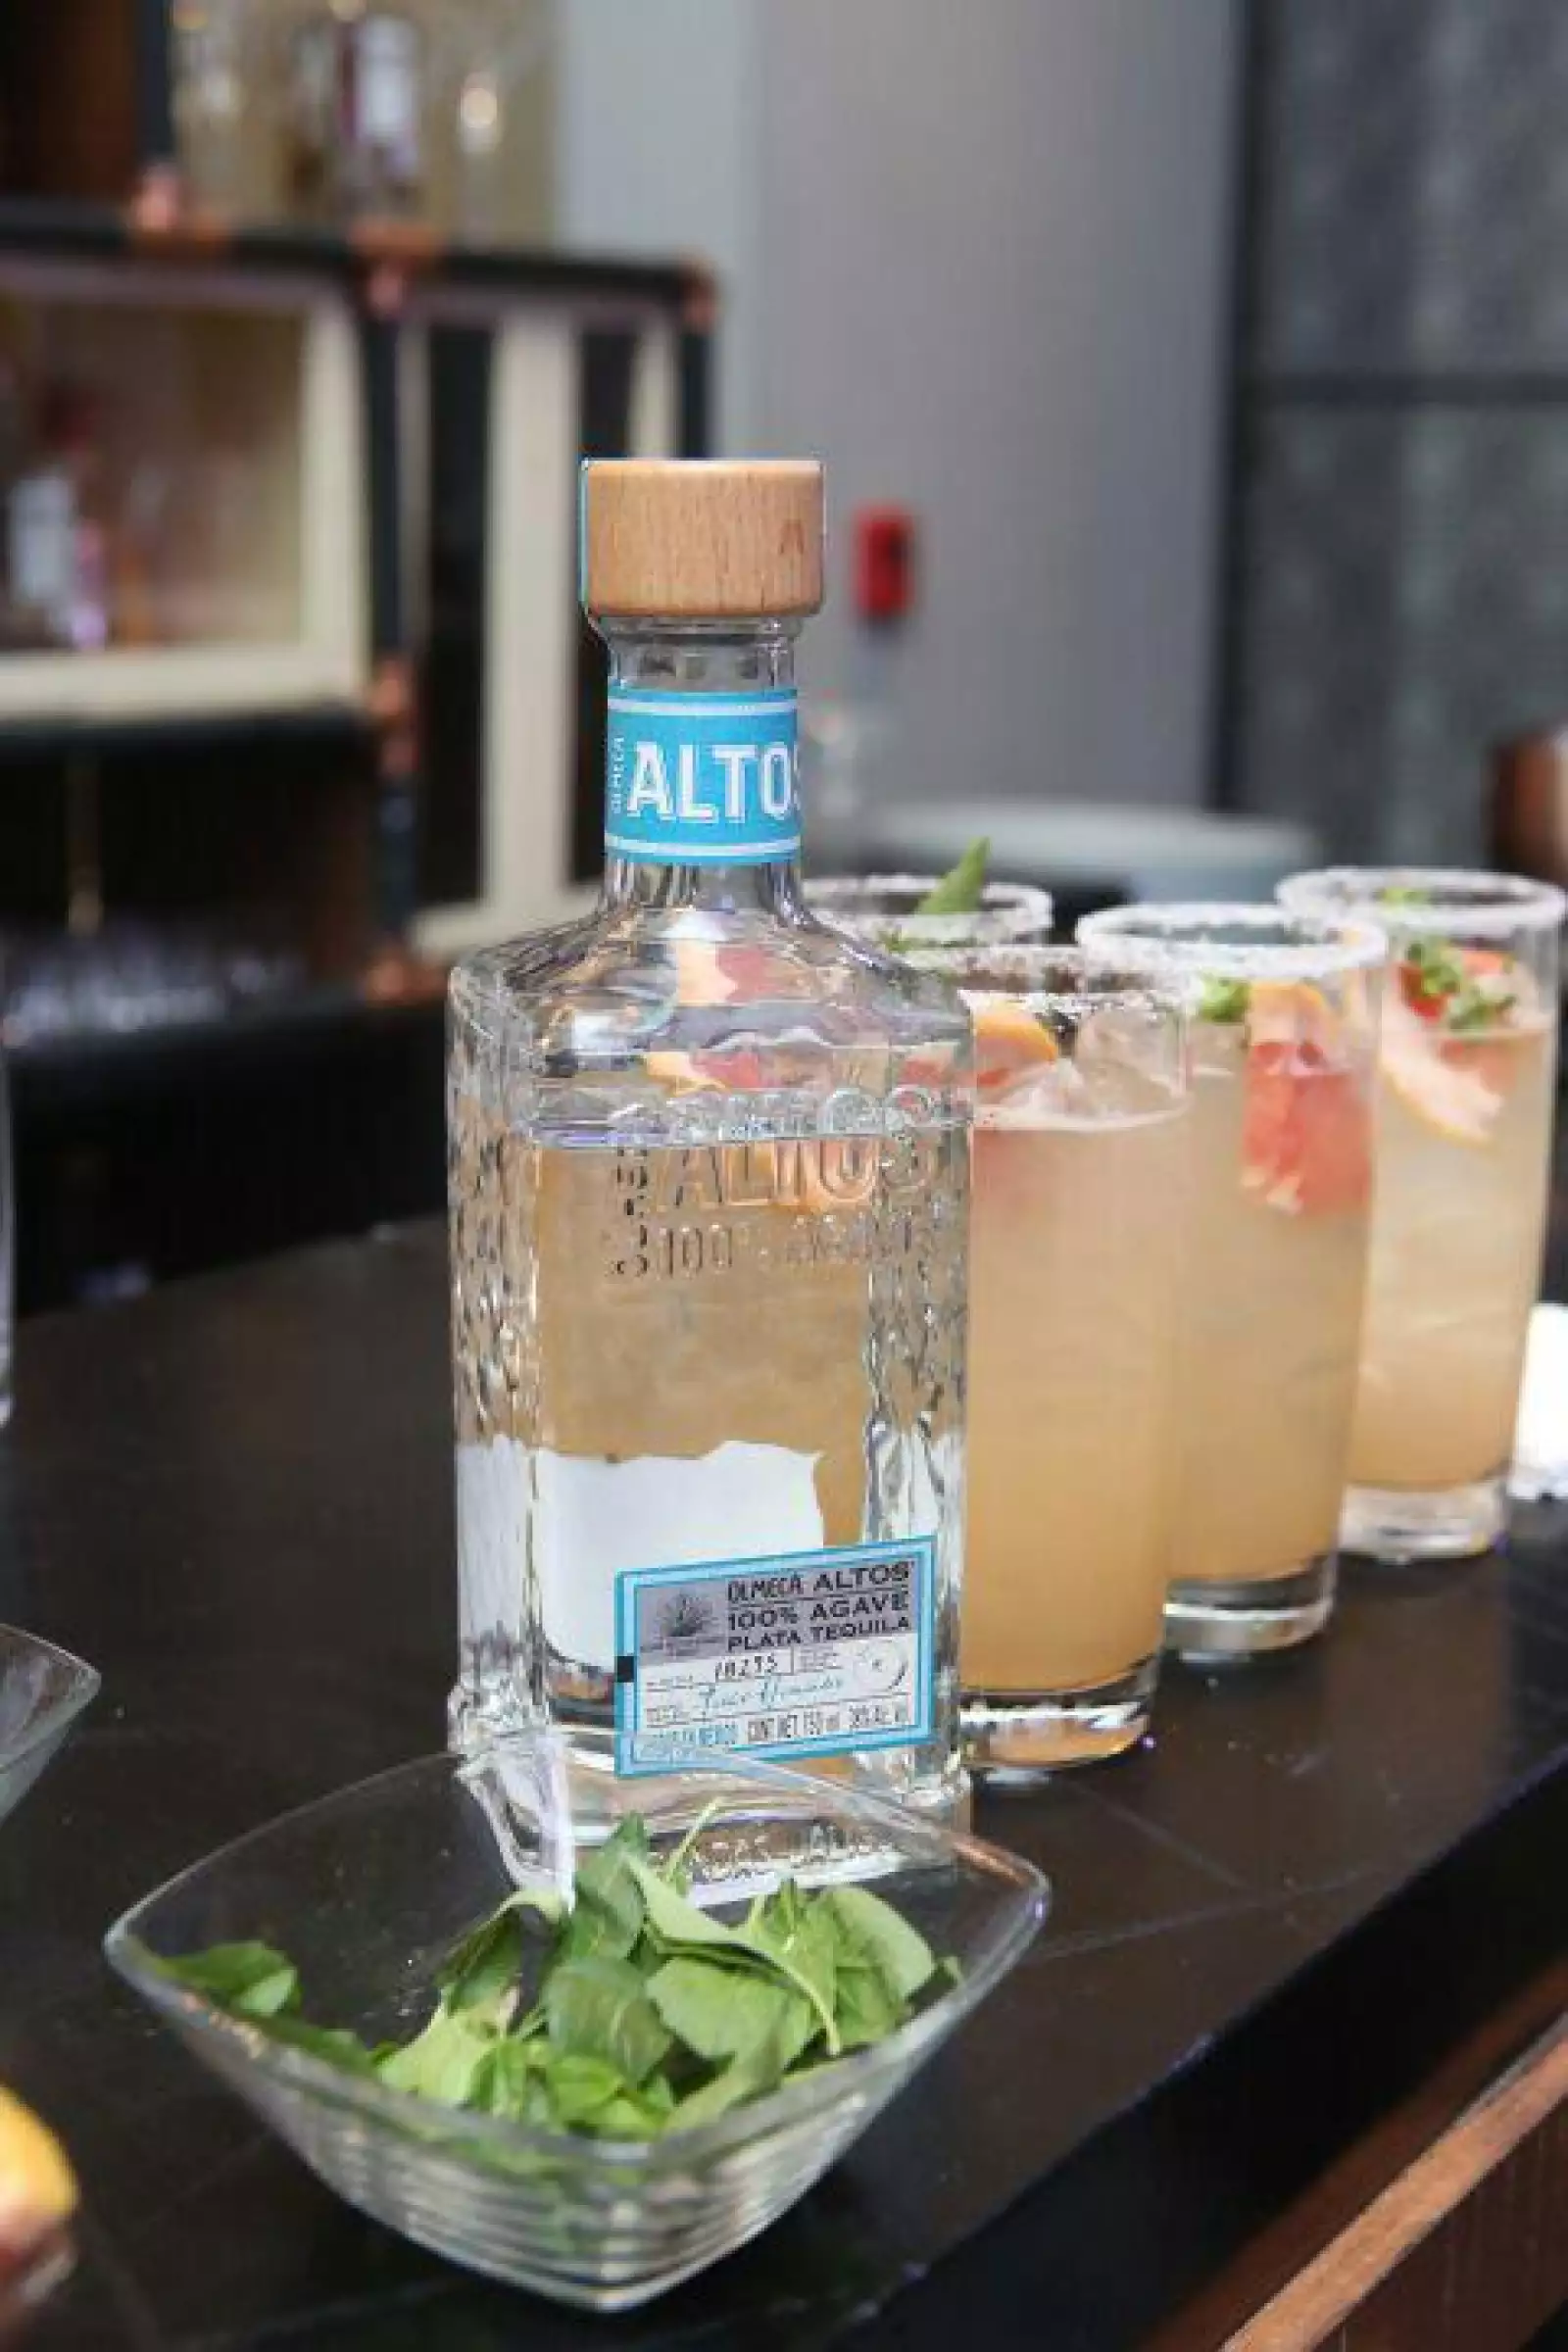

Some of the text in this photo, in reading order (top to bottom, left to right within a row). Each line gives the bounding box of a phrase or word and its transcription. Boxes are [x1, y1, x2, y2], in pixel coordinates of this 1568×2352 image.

[727, 1561, 910, 1603] OLMECA ALTOS
[727, 1590, 910, 1631] 100% AGAVE
[727, 1630, 803, 1653] PLATA
[809, 1616, 910, 1643] TEQUILA
